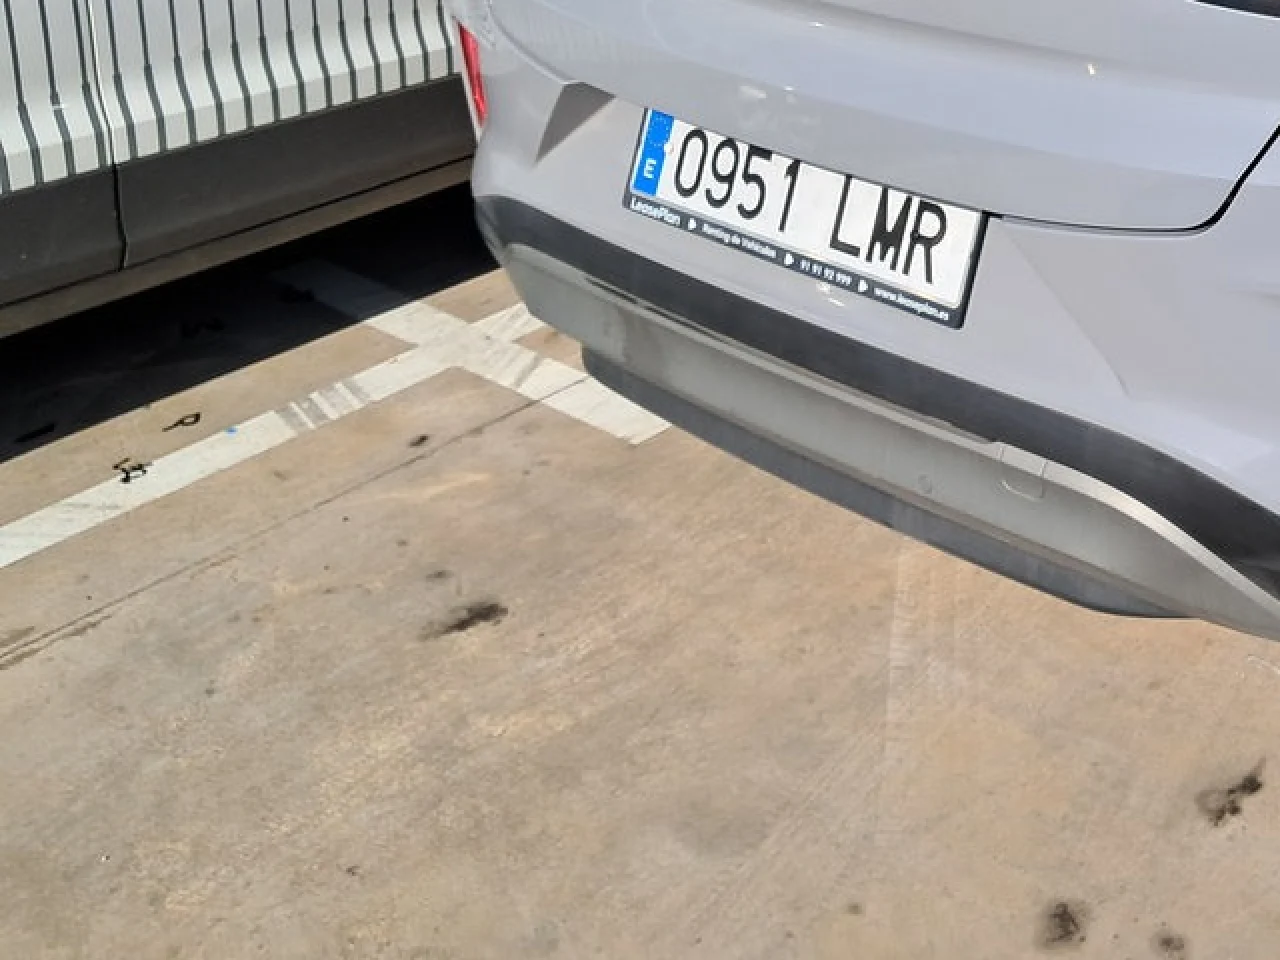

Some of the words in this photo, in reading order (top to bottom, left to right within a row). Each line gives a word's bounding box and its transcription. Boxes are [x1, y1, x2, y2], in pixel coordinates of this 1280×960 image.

[643, 158, 657, 179] E
[675, 127, 801, 232] 0951
[829, 173, 947, 284] LMR
